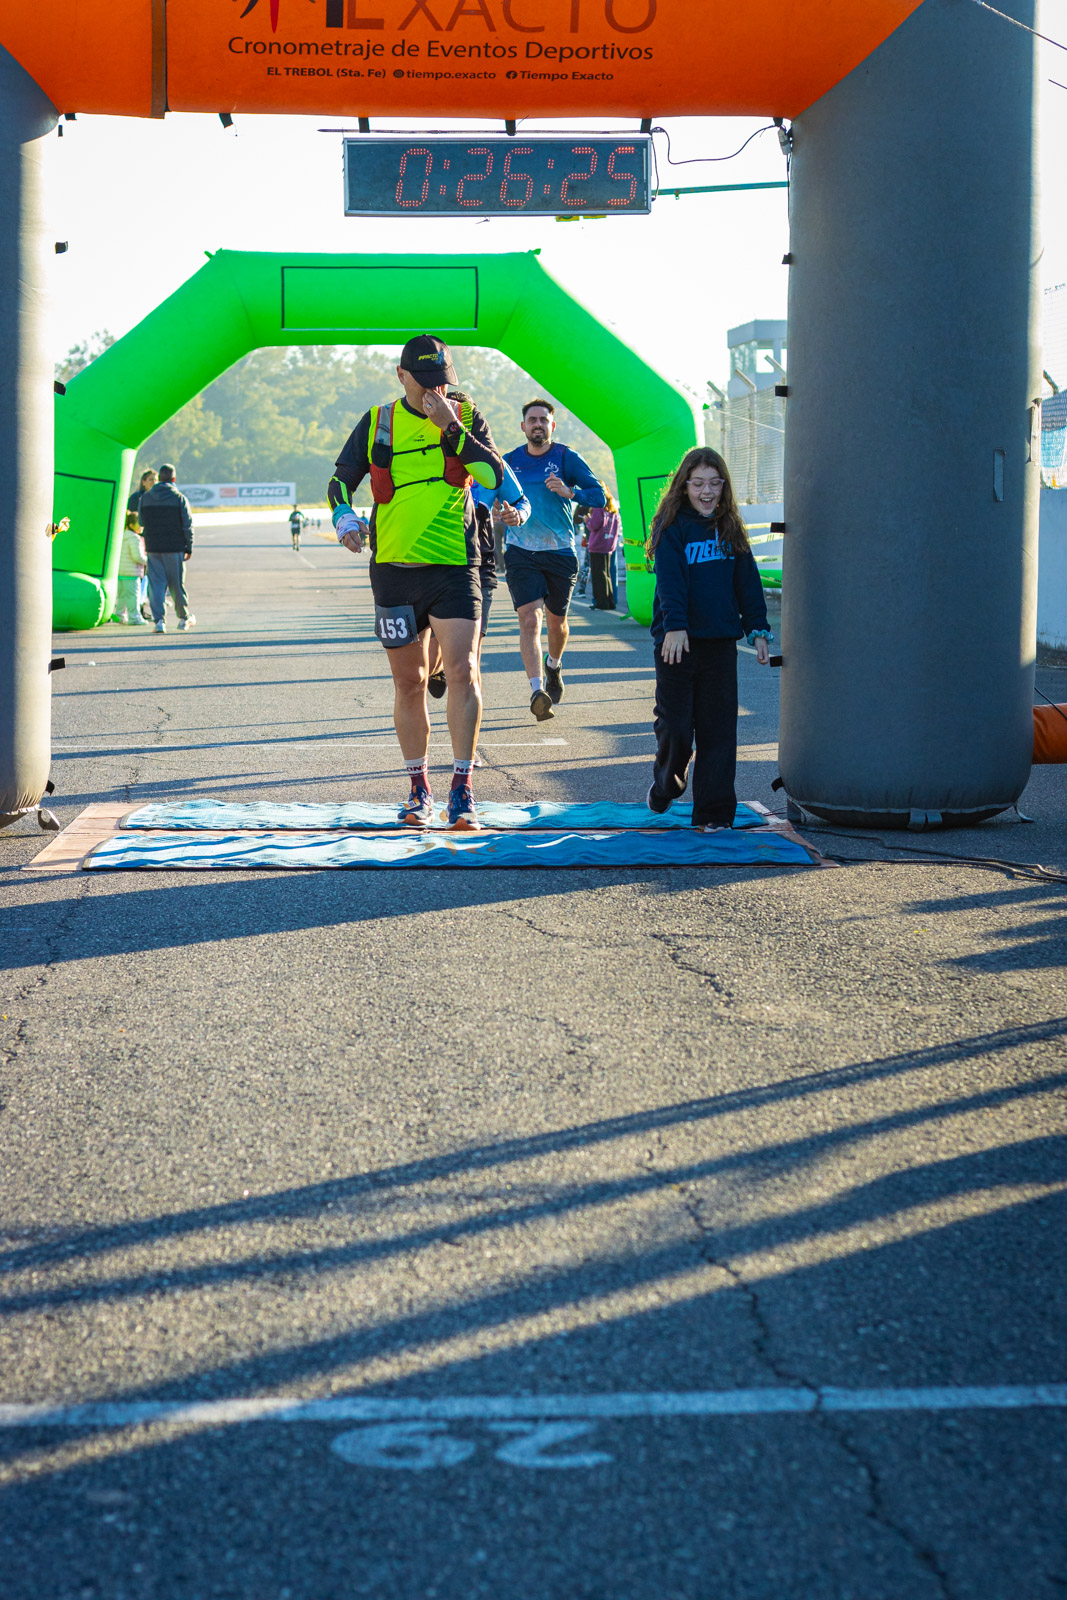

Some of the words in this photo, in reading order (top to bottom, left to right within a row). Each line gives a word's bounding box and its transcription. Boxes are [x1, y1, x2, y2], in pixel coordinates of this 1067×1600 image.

[228, 37, 385, 60] Cronometraje
[391, 39, 420, 57] de
[427, 40, 518, 58] Eventos
[525, 41, 653, 62] Deportivos
[267, 67, 281, 76] EL
[284, 68, 333, 77] TREBOL
[336, 68, 364, 78] (Sta.
[367, 69, 386, 79] Fe)
[406, 69, 496, 80] tiempo.exacto
[520, 70, 568, 82] Tiempo
[572, 71, 614, 81] Exacto
[395, 147, 637, 207] 0:26:25
[241, 487, 287, 497] LONG
[379, 617, 408, 639] 153
